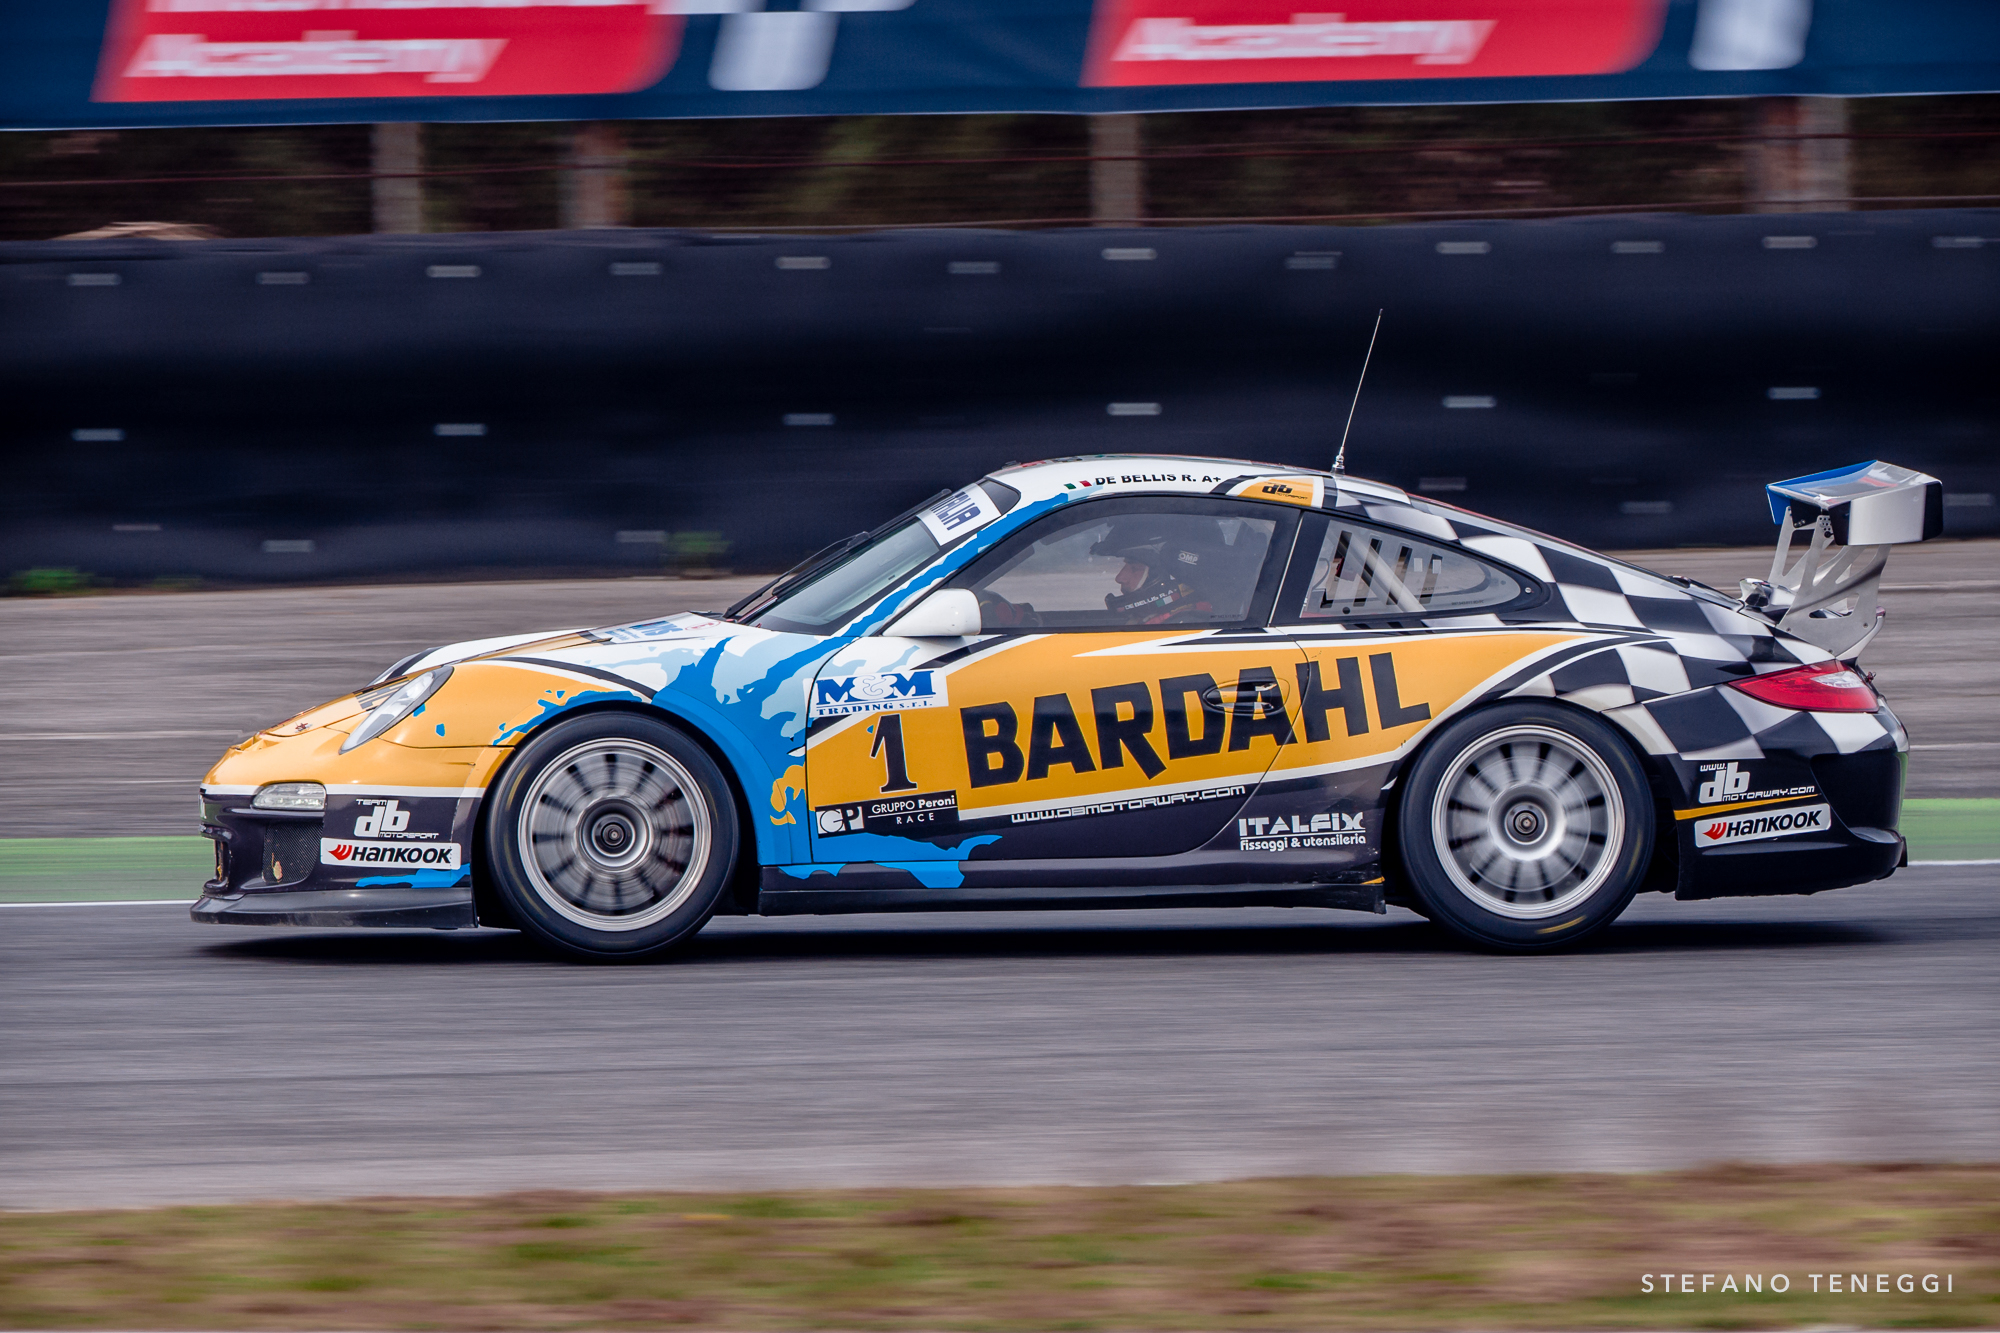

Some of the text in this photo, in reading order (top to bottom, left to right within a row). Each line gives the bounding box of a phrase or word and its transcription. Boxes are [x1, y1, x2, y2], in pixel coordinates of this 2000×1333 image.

[1095, 473, 1222, 486] DE BELLIS R. A+
[1178, 552, 1199, 563] OMP
[816, 670, 936, 705] M&M
[816, 702, 894, 716] TRADING
[959, 652, 1431, 789] BARDAHL
[869, 713, 918, 793] 1
[1699, 762, 1750, 804] db
[871, 795, 956, 815] GRUPPO Peroni
[354, 800, 411, 837] db
[896, 812, 934, 825] RACE
[1240, 832, 1366, 852] fissaggi & utensileria
